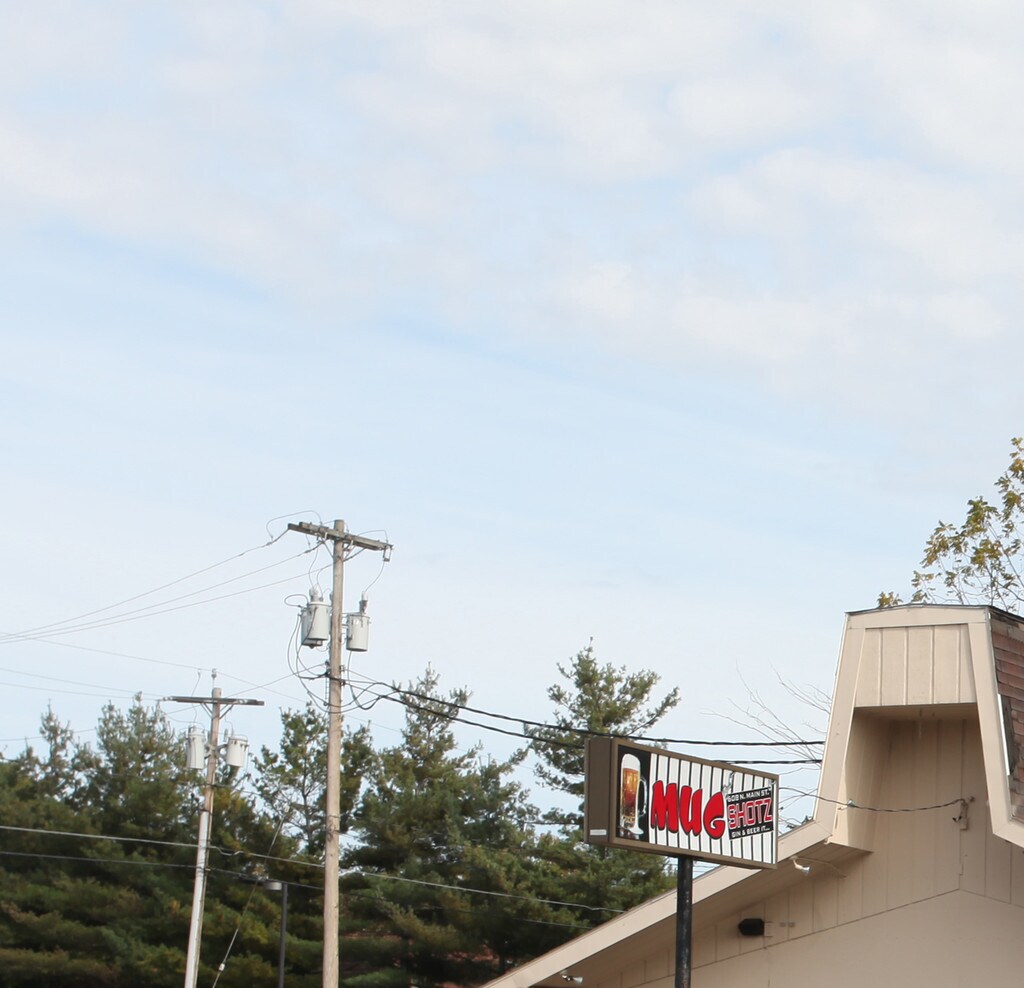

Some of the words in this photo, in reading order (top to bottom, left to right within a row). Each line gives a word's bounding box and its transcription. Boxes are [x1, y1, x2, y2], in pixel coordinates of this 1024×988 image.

[651, 780, 726, 840] MUG
[746, 791, 760, 799] MAIN
[728, 797, 773, 830] SHOTZ
